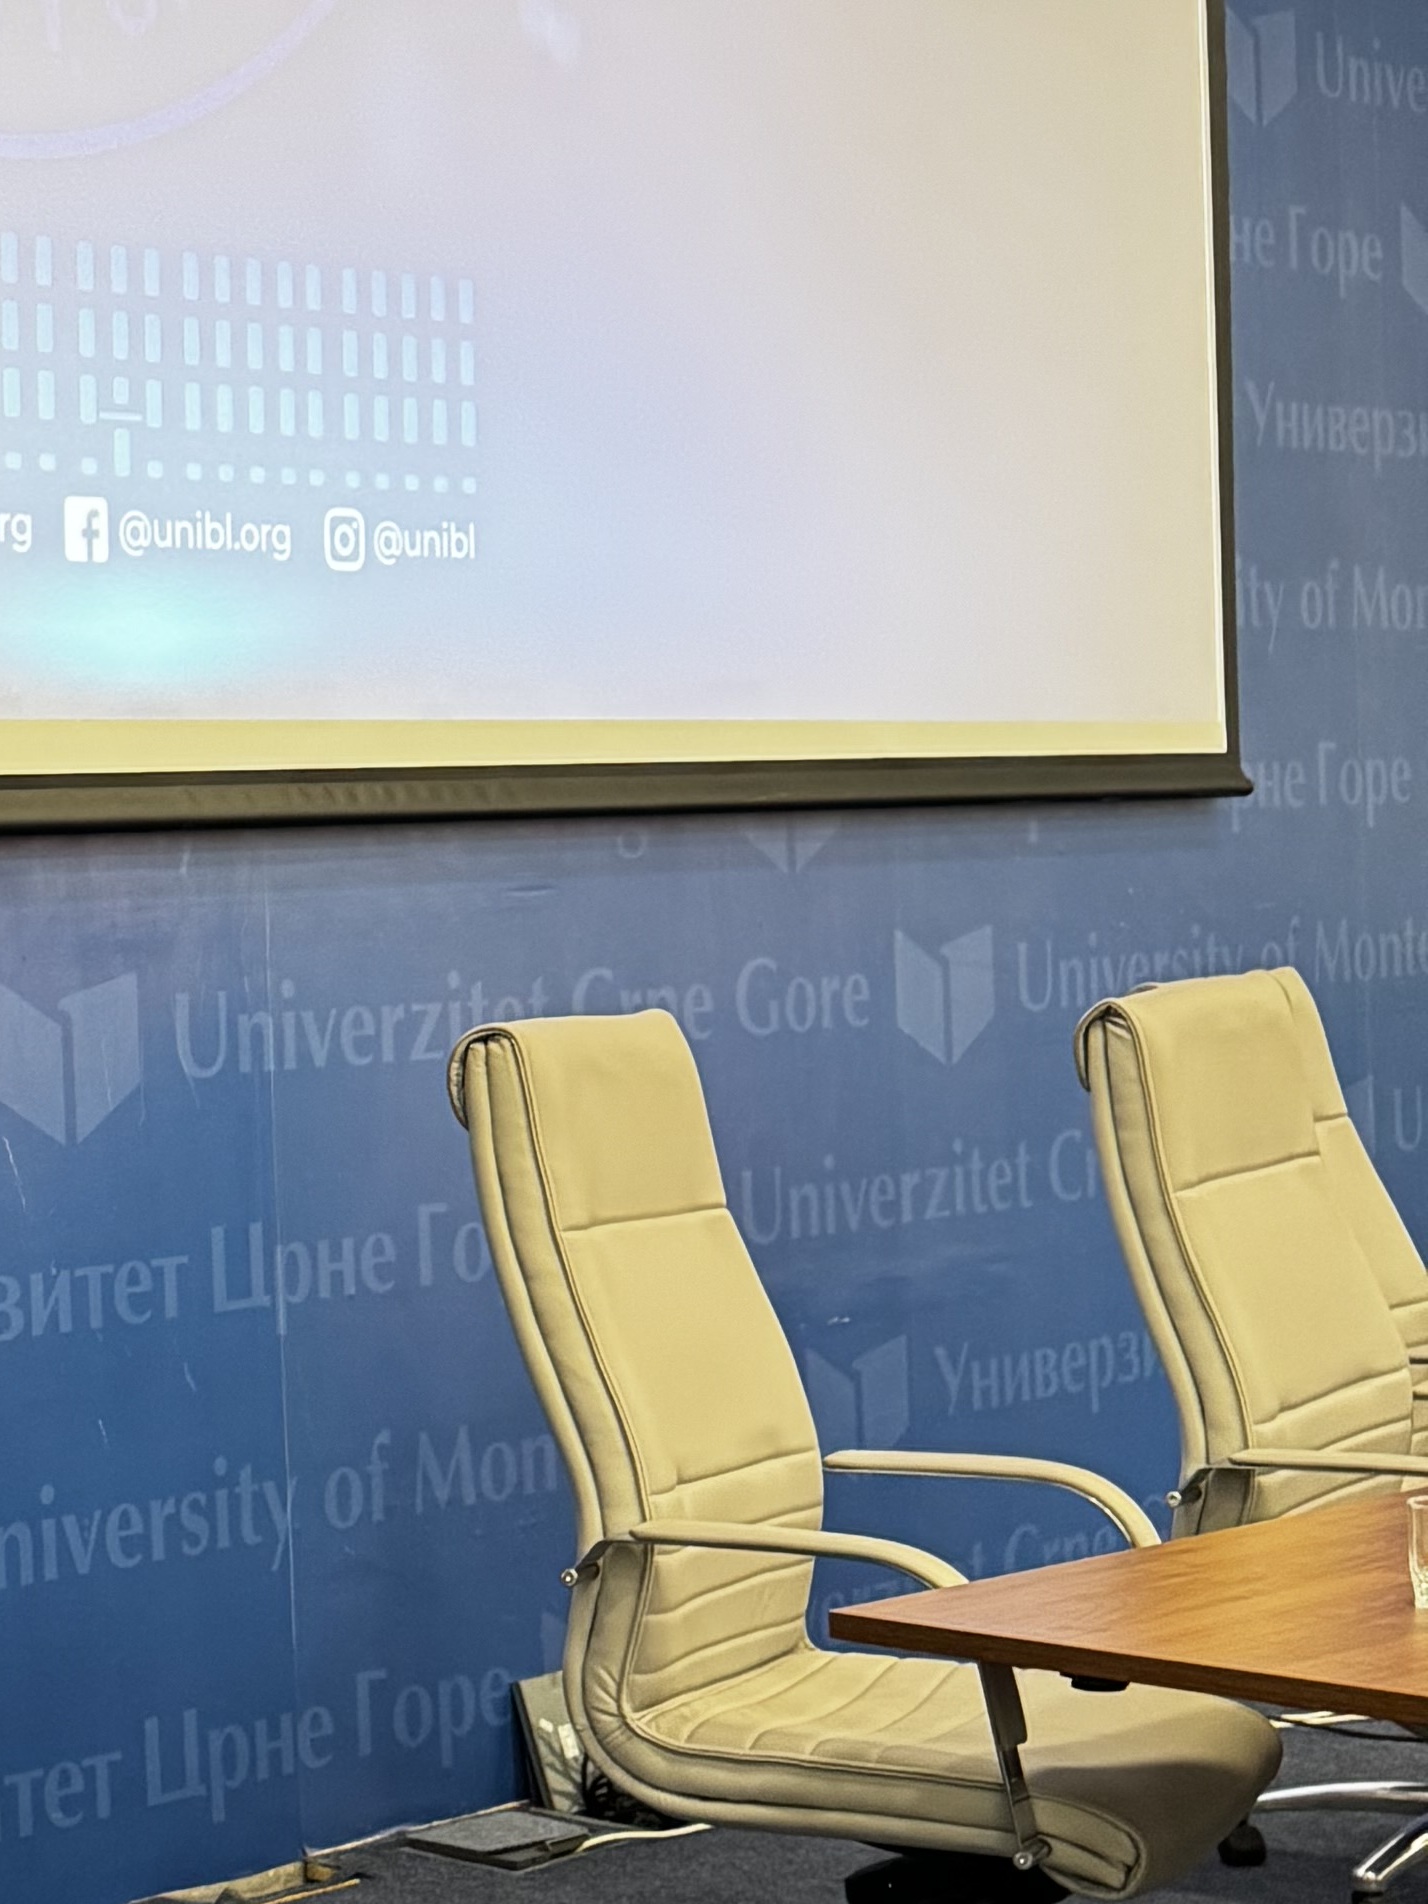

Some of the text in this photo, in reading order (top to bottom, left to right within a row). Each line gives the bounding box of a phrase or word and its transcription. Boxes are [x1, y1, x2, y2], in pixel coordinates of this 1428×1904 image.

[119, 508, 293, 562] @unibl.org
[373, 517, 476, 565] @unibl
[1318, 741, 1412, 829] Горе
[735, 956, 871, 1038] Gore
[744, 1139, 1034, 1246] Univerzitet
[210, 1220, 398, 1337] Црне
[325, 1428, 390, 1529] of
[143, 1702, 336, 1822] Црне
